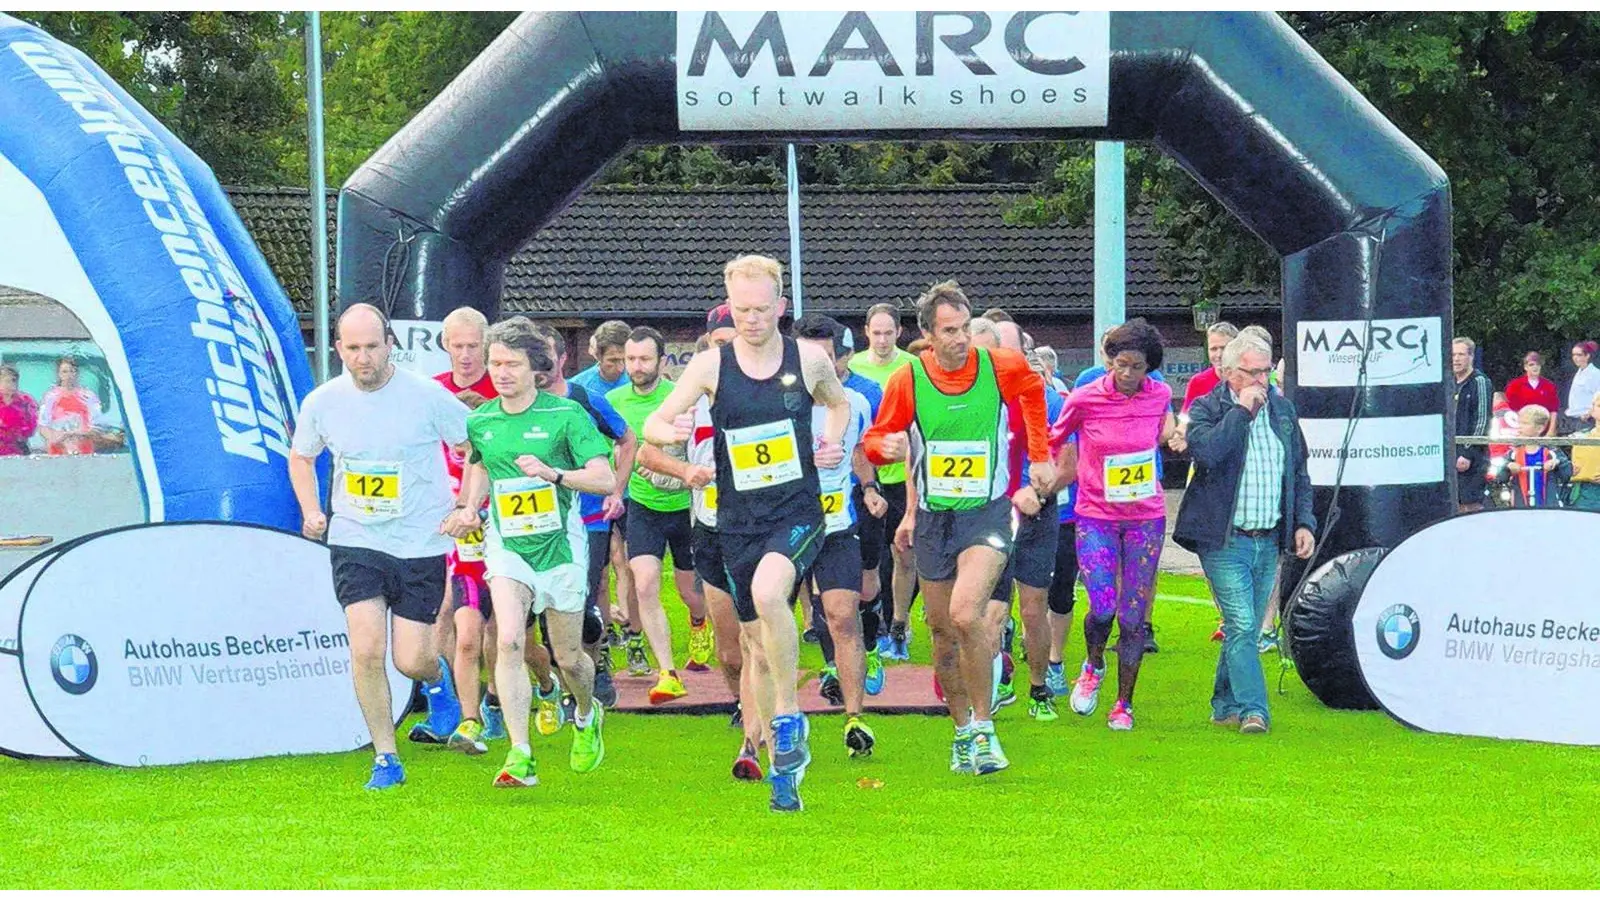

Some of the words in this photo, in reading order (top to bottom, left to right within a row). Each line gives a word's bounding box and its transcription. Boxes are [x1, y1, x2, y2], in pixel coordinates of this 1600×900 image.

[686, 11, 1087, 78] MARC
[685, 86, 918, 107] softwalk
[949, 86, 1089, 106] shoes
[1302, 325, 1419, 352] MARC
[755, 443, 771, 465] 8
[1307, 444, 1440, 459] ww.marcshoes.com
[943, 457, 973, 478] 22
[1119, 467, 1145, 485] 24
[356, 476, 385, 497] 12
[510, 494, 540, 516] 21
[1447, 613, 1537, 638] Autohaus
[124, 638, 221, 660] Autohaus
[1444, 639, 1495, 661] BMW
[128, 665, 183, 687] BMW
[190, 656, 350, 687] Vertragshändler
